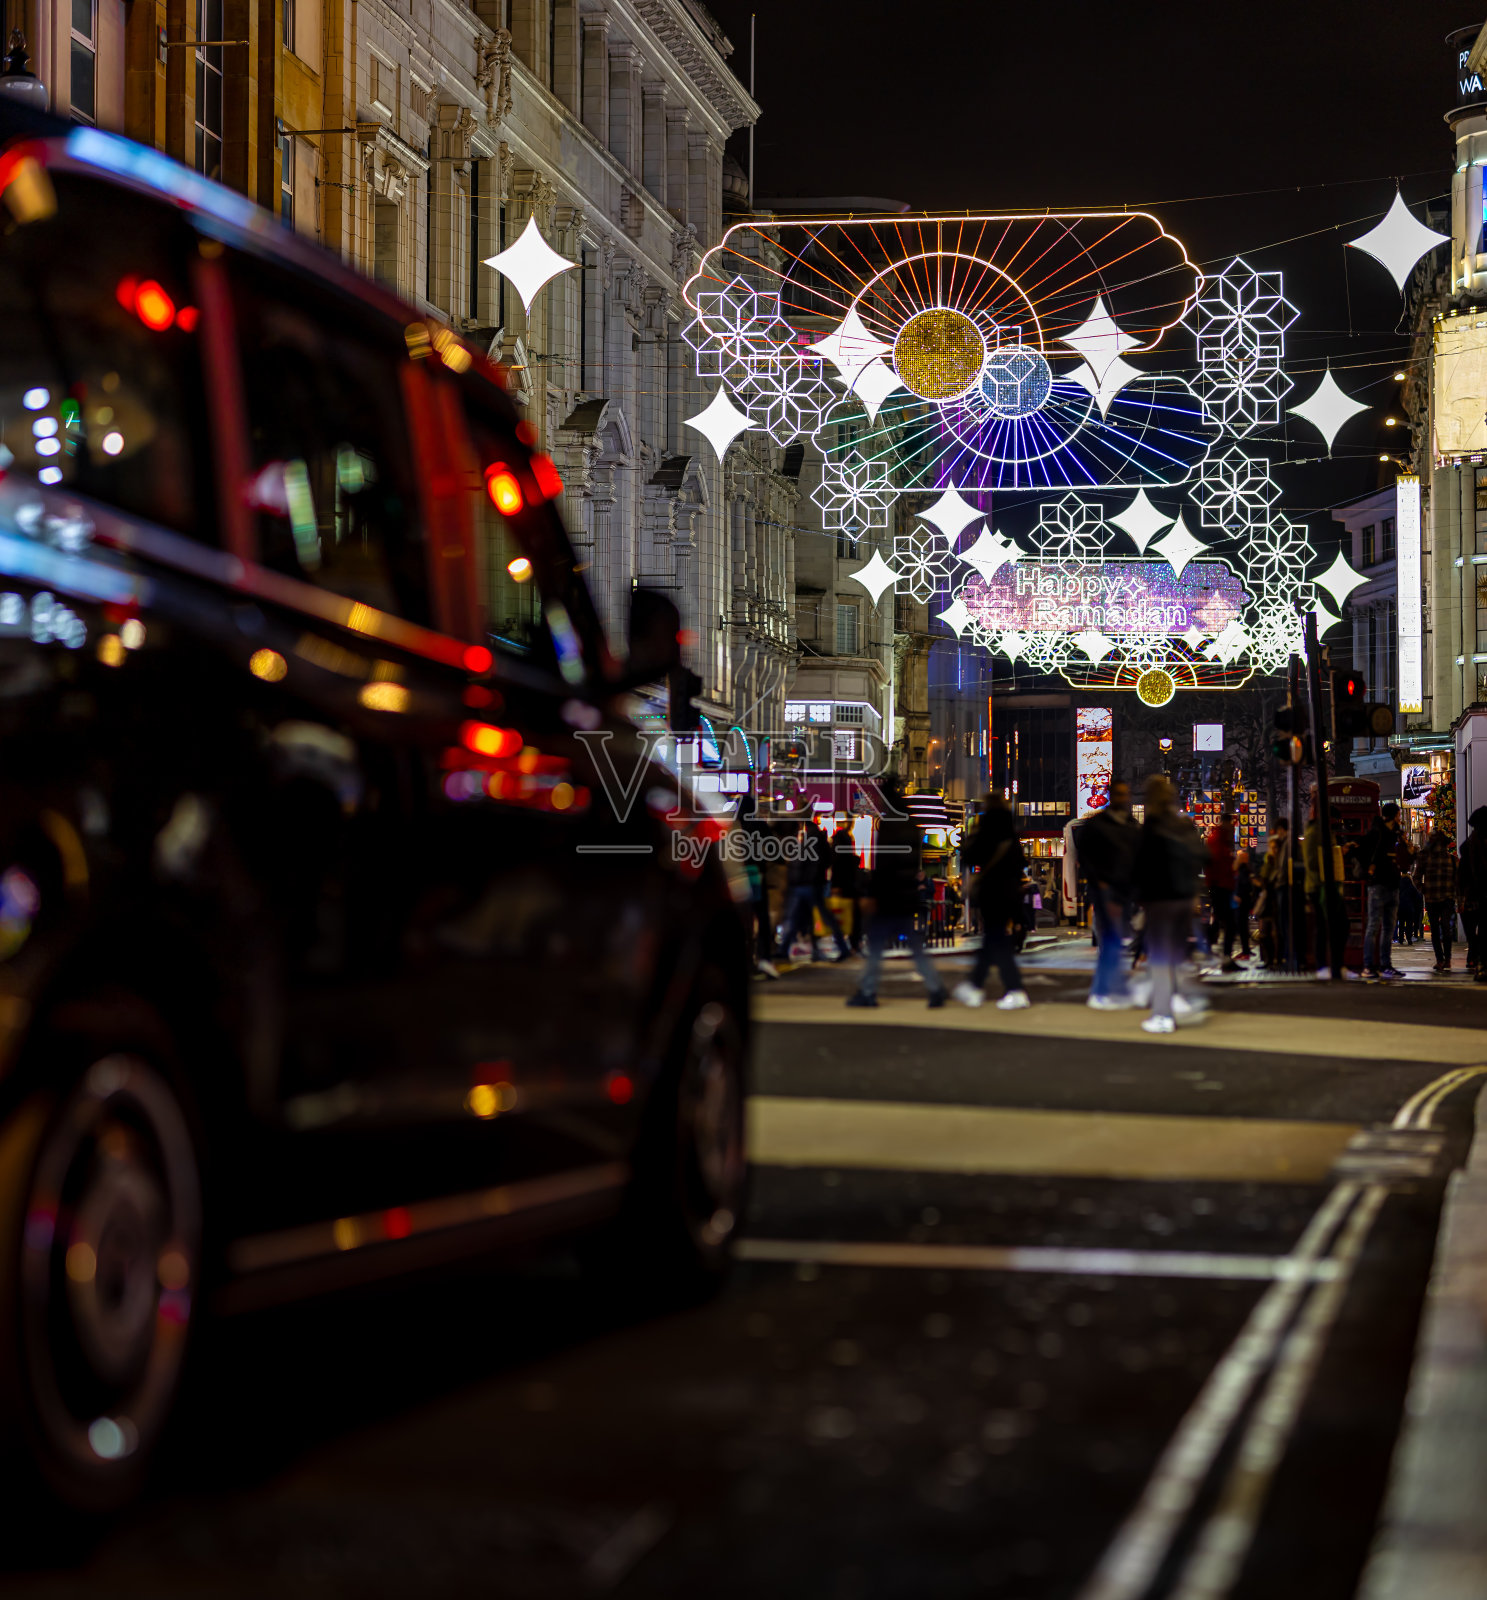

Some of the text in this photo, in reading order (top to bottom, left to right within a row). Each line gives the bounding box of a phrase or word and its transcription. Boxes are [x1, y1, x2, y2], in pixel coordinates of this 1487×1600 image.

[1459, 75, 1486, 95] WA
[1016, 567, 1124, 603] Happy
[1032, 598, 1188, 626] Ramadan
